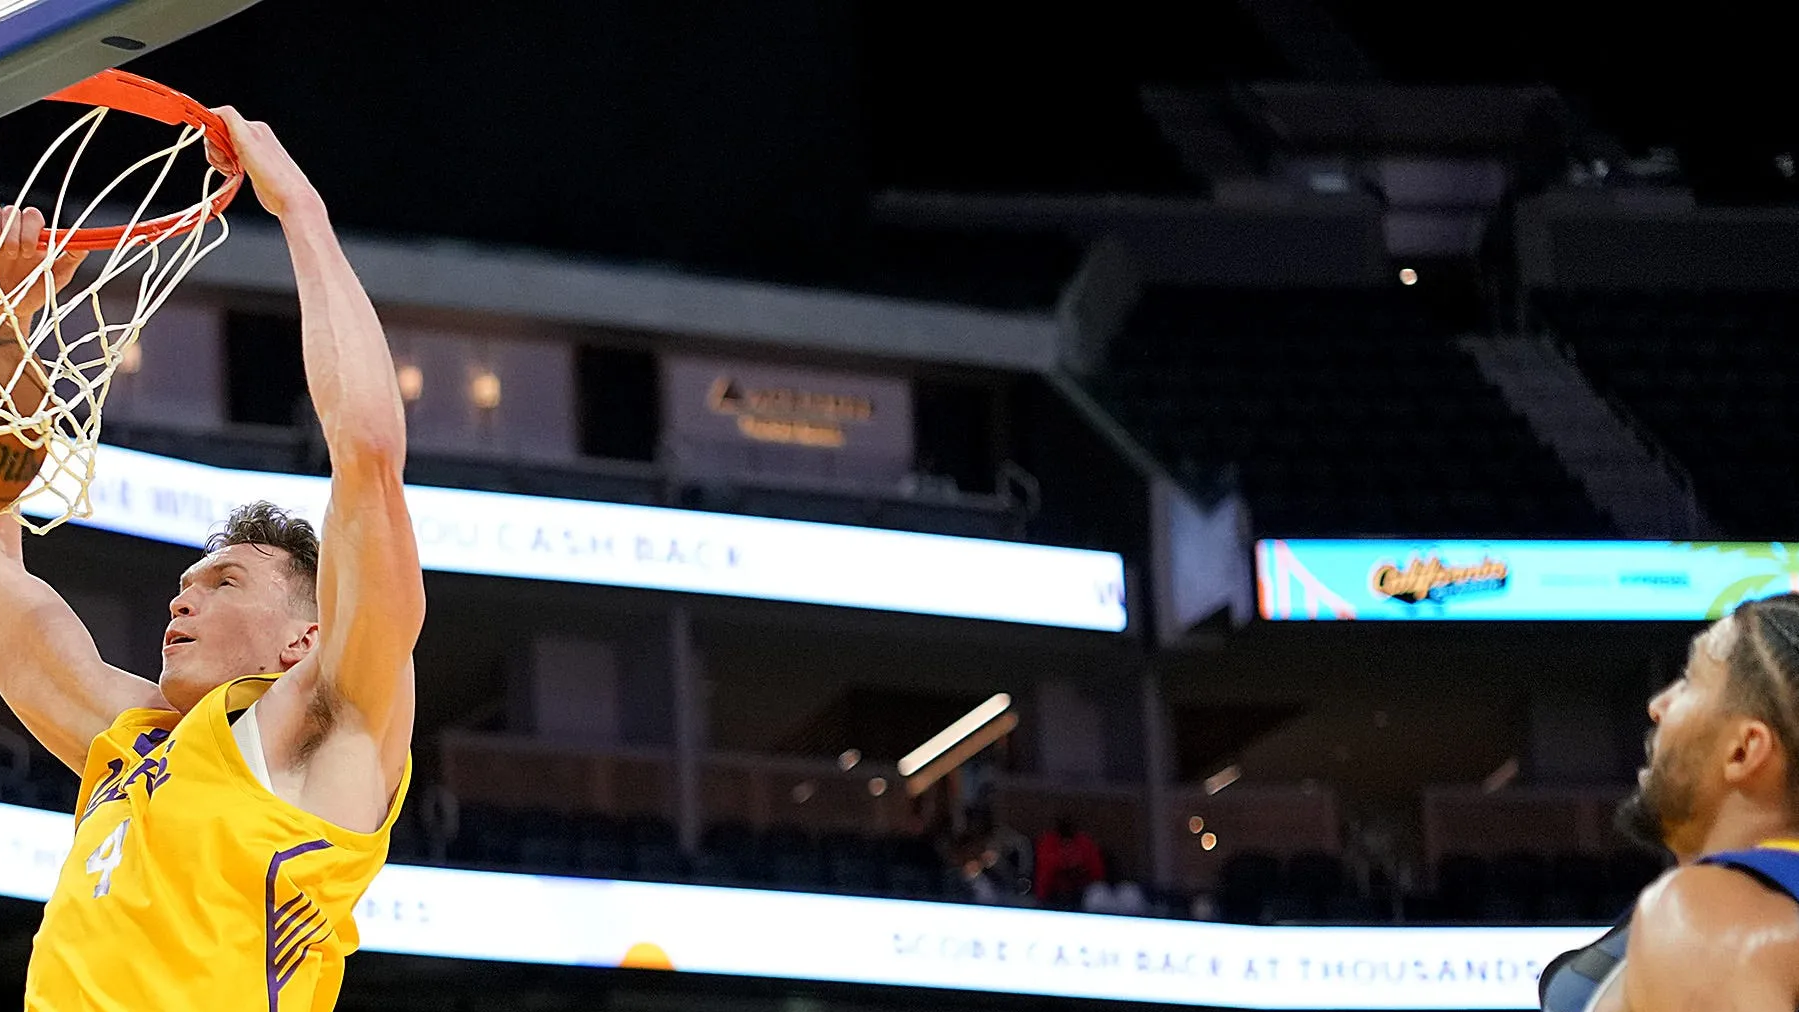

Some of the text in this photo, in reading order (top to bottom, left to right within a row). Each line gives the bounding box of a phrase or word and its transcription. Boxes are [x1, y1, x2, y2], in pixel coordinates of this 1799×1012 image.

[417, 515, 744, 570] OU CASH BACK
[86, 817, 131, 898] 4
[1242, 957, 1281, 982] AT
